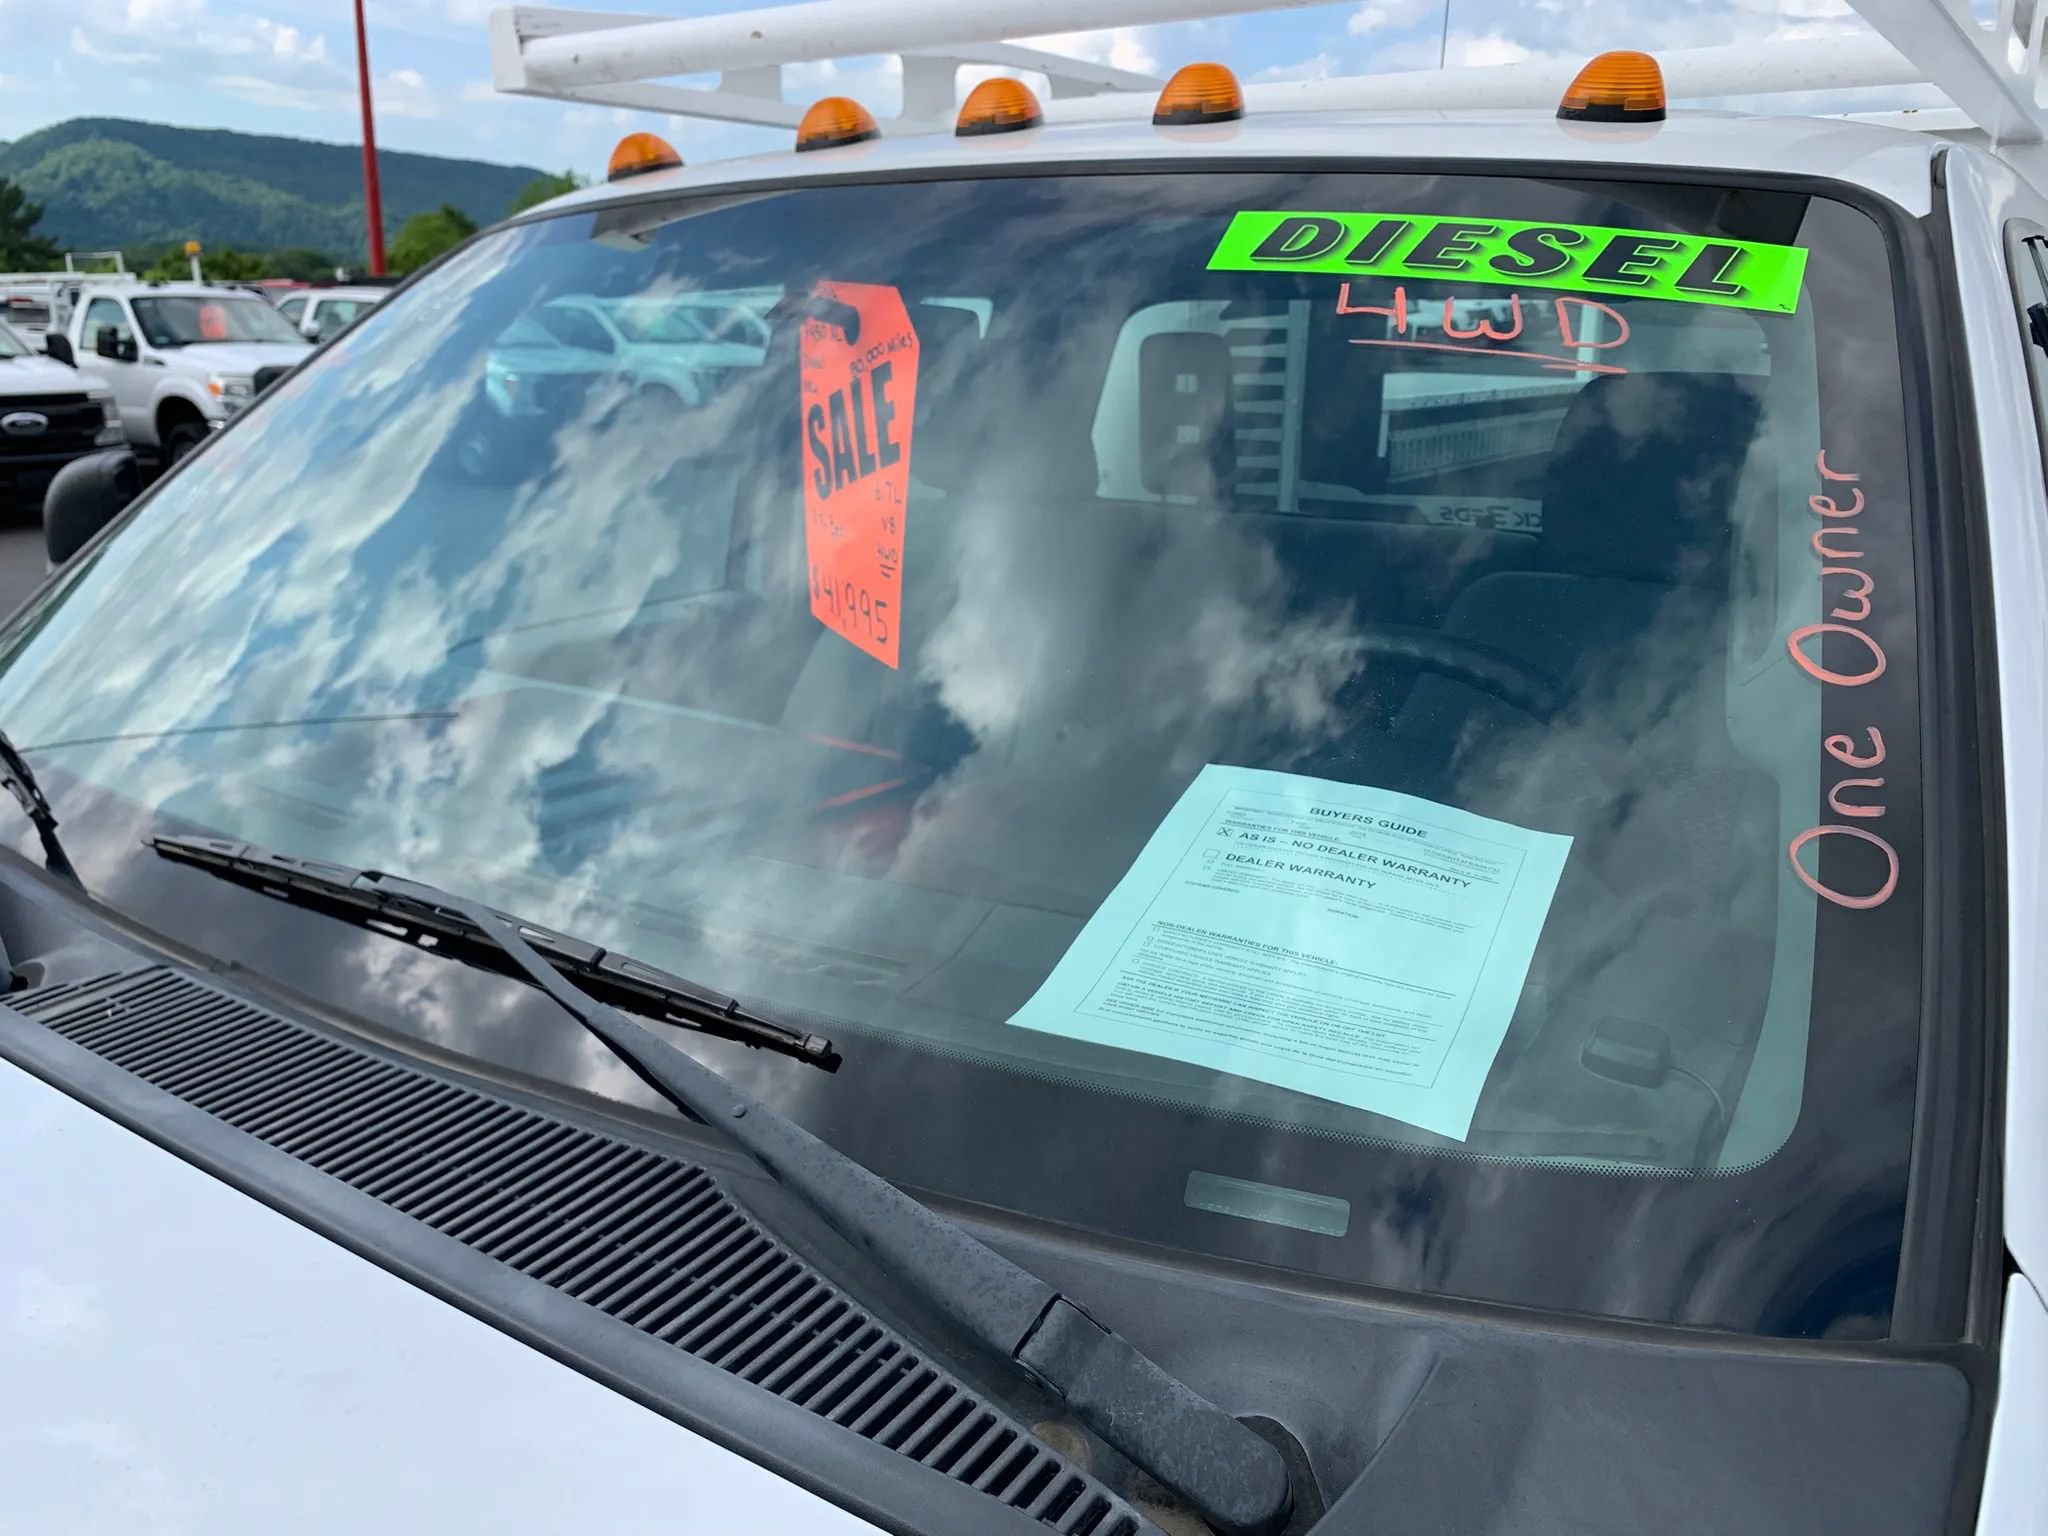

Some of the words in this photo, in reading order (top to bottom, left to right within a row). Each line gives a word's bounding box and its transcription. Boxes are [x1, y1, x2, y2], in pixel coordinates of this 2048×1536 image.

[1249, 216, 1751, 297] DIESEL
[1335, 282, 1631, 350] 4WD
[807, 360, 901, 500] SALE
[811, 563, 888, 645] $41,995
[1787, 447, 1888, 688] Owner
[1309, 807, 1374, 825] BUYERS
[1377, 819, 1429, 838] GUIDE
[1789, 726, 1900, 910] One
[1225, 853, 1285, 870] DEALER
[1289, 864, 1377, 889] WARRANTY
[1238, 832, 1260, 841] AS
[1262, 835, 1277, 844] IS
[1291, 840, 1314, 850] NO
[1317, 844, 1379, 864] DEALER
[1382, 859, 1472, 889] WARRANTY
[1157, 920, 1207, 935] NON-DEALER
[1208, 931, 1261, 948] WARRANTIES
[1262, 943, 1280, 952] FOR
[1281, 947, 1299, 957] THIS
